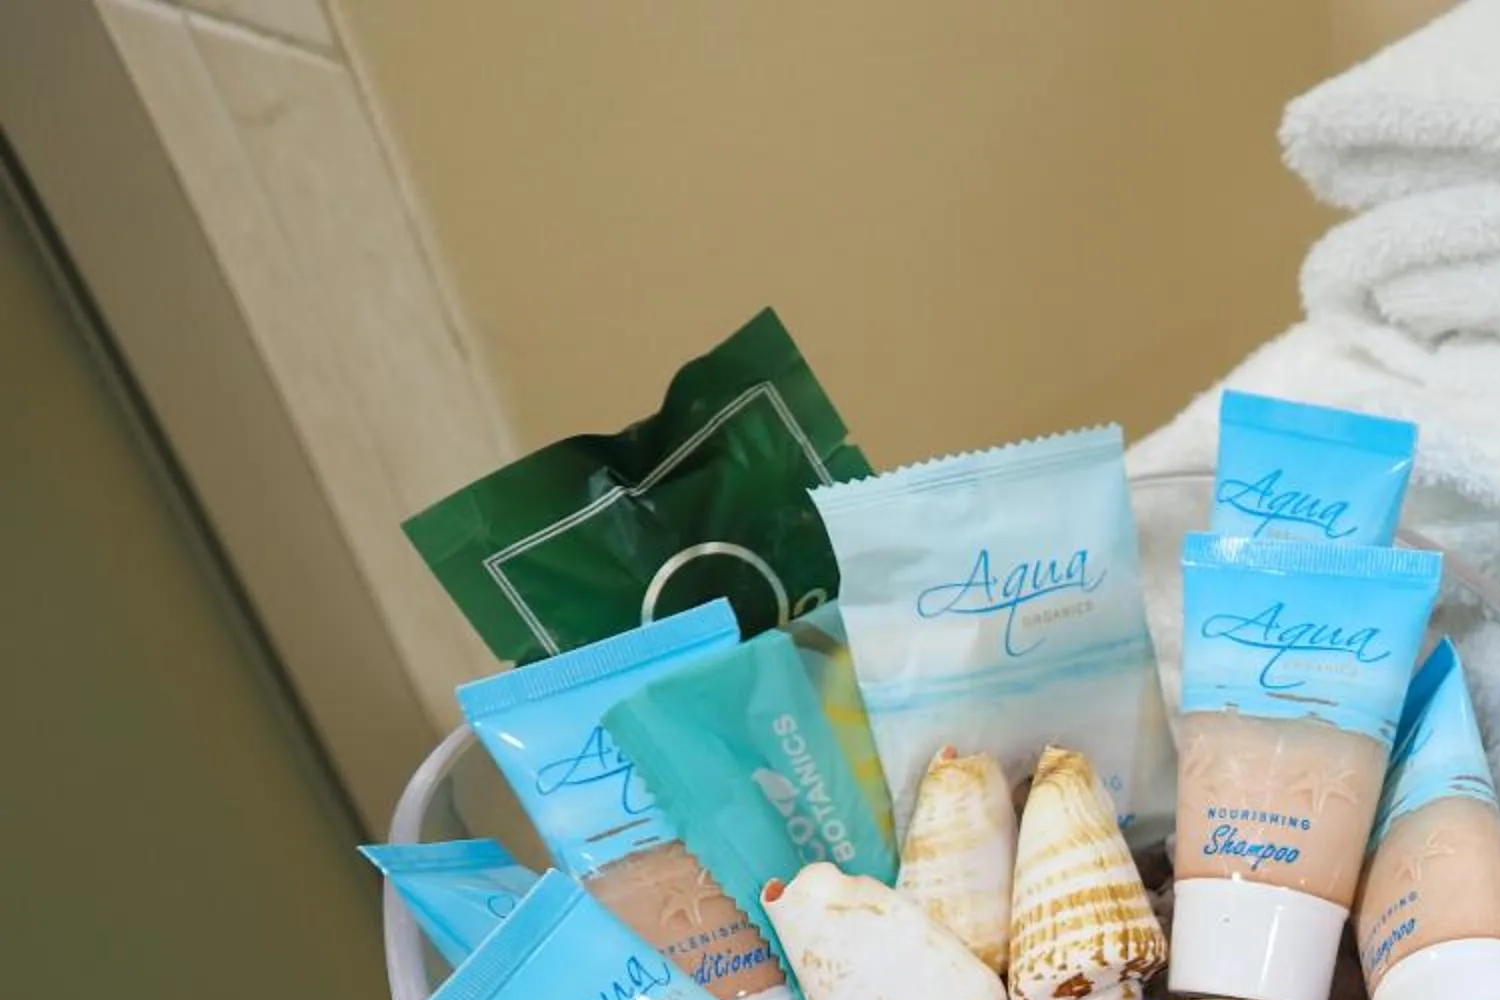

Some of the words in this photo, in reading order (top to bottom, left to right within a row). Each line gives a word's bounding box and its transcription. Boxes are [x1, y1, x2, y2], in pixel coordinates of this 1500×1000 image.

[1217, 469, 1358, 538] Aqua
[918, 549, 1107, 657] Aqua
[1202, 601, 1391, 689] Aqua
[773, 713, 856, 863] BOTANICS
[1207, 807, 1311, 830] NOURISHING
[1203, 824, 1301, 872] Shampoo
